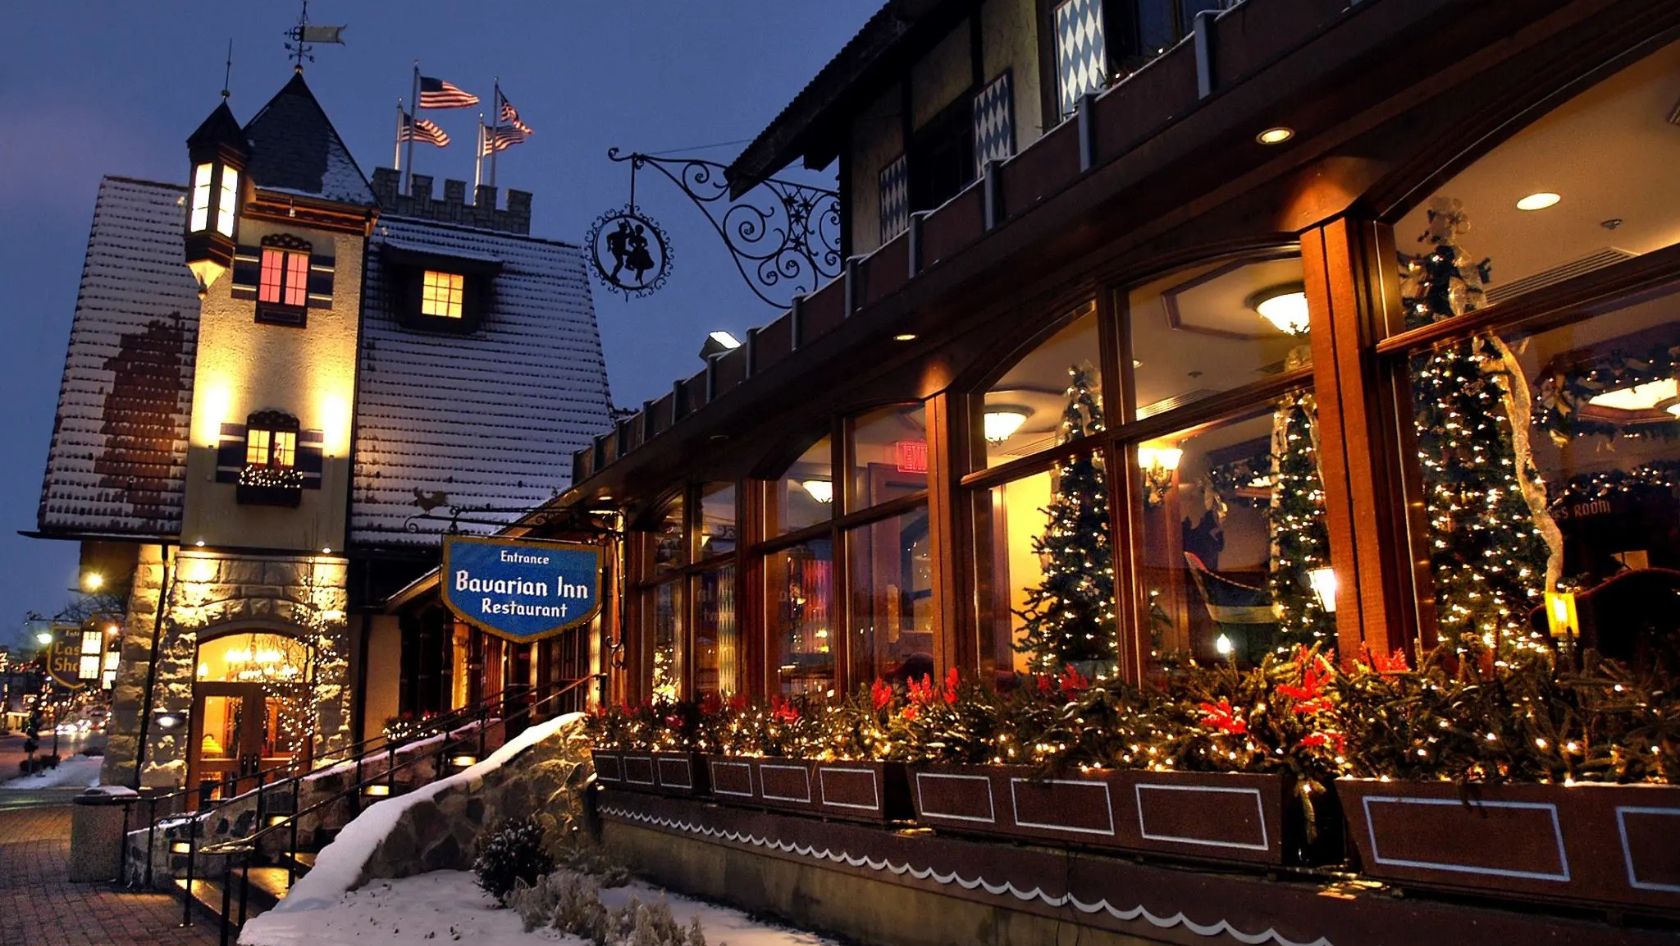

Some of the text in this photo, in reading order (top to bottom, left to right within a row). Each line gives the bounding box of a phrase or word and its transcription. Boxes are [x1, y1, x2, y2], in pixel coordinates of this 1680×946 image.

[500, 550, 550, 564] Entrance
[456, 570, 588, 599] Bavarian Inn
[482, 597, 567, 618] Restaurant
[55, 641, 80, 656] Cas
